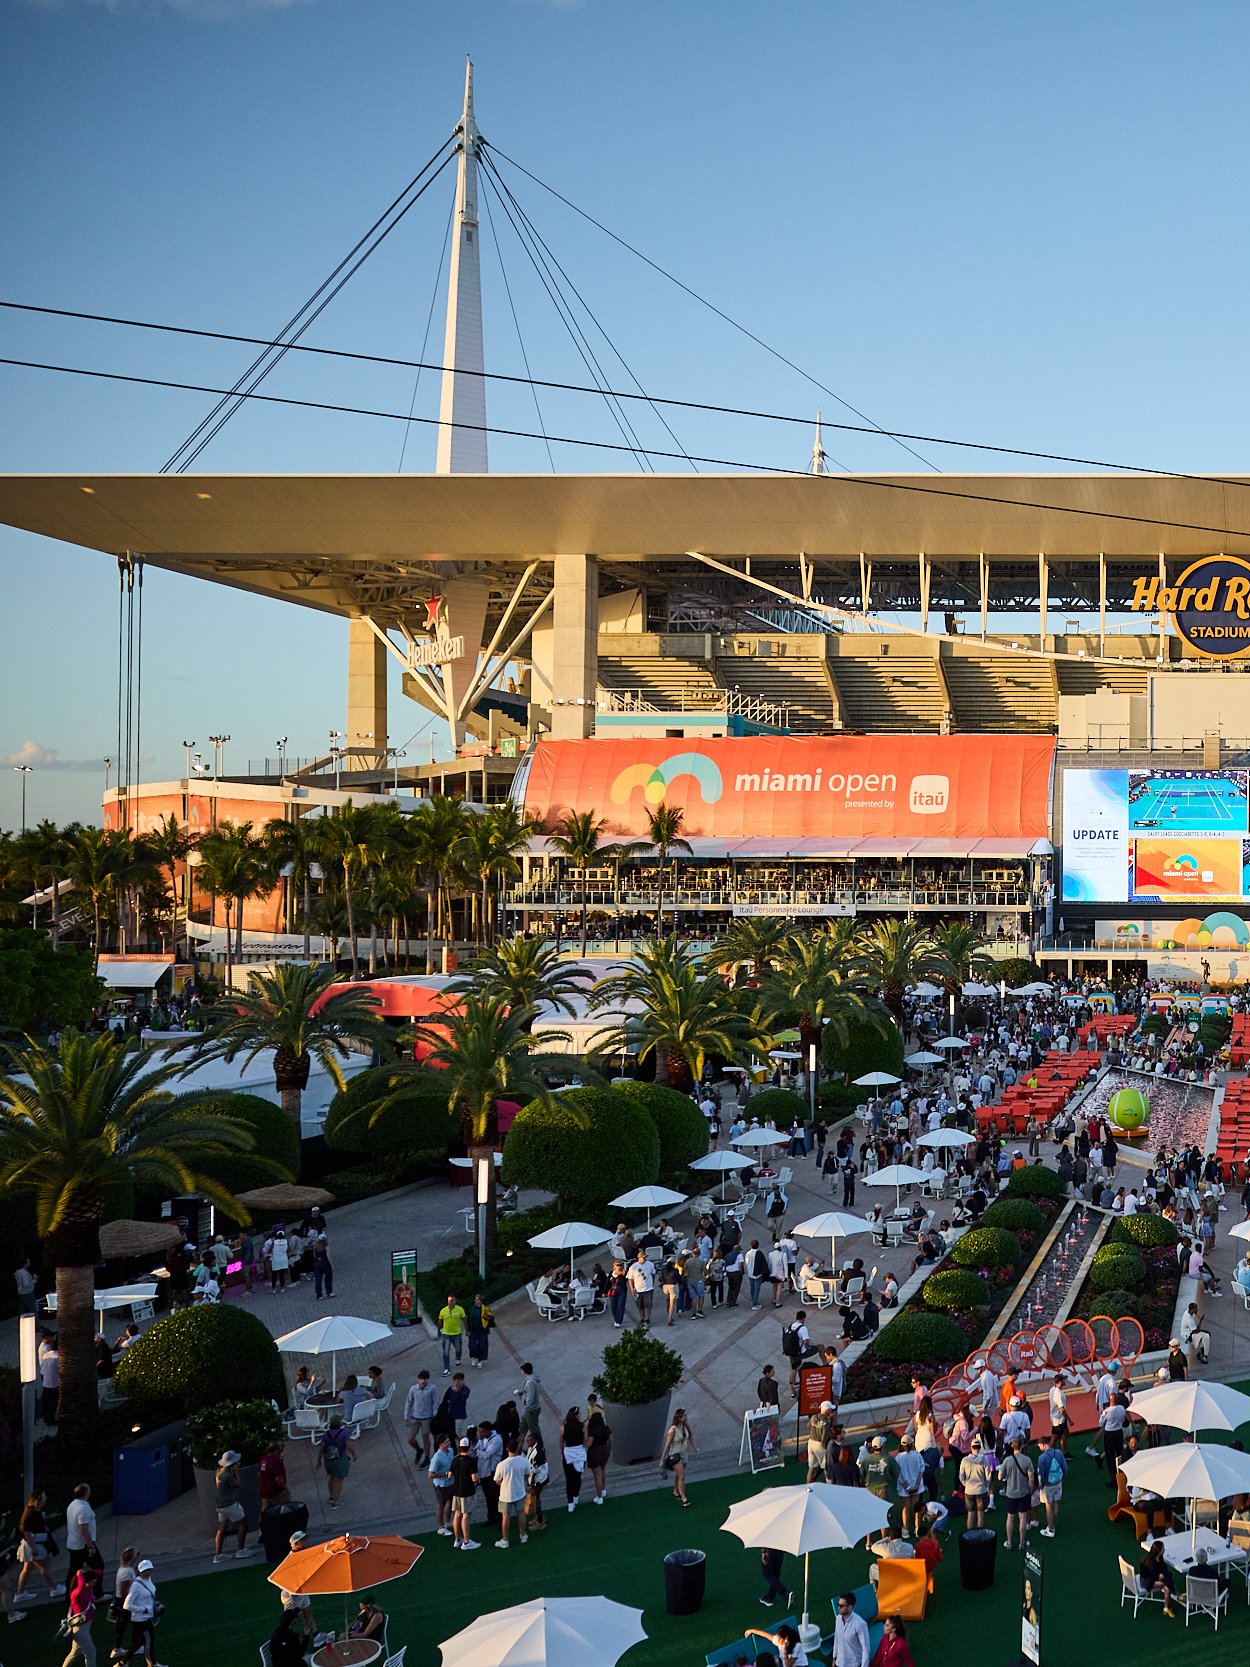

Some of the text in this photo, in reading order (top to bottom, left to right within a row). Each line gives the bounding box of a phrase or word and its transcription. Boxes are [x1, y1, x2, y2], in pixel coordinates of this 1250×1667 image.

[1131, 576, 1220, 611] Hard
[1190, 626, 1250, 638] STADIUM
[408, 635, 464, 668] Heineken
[735, 768, 896, 797] miami open
[845, 800, 894, 810] presented by
[913, 790, 944, 807] itaú
[1073, 830, 1119, 840] UPDATE
[798, 906, 824, 914] Lounge
